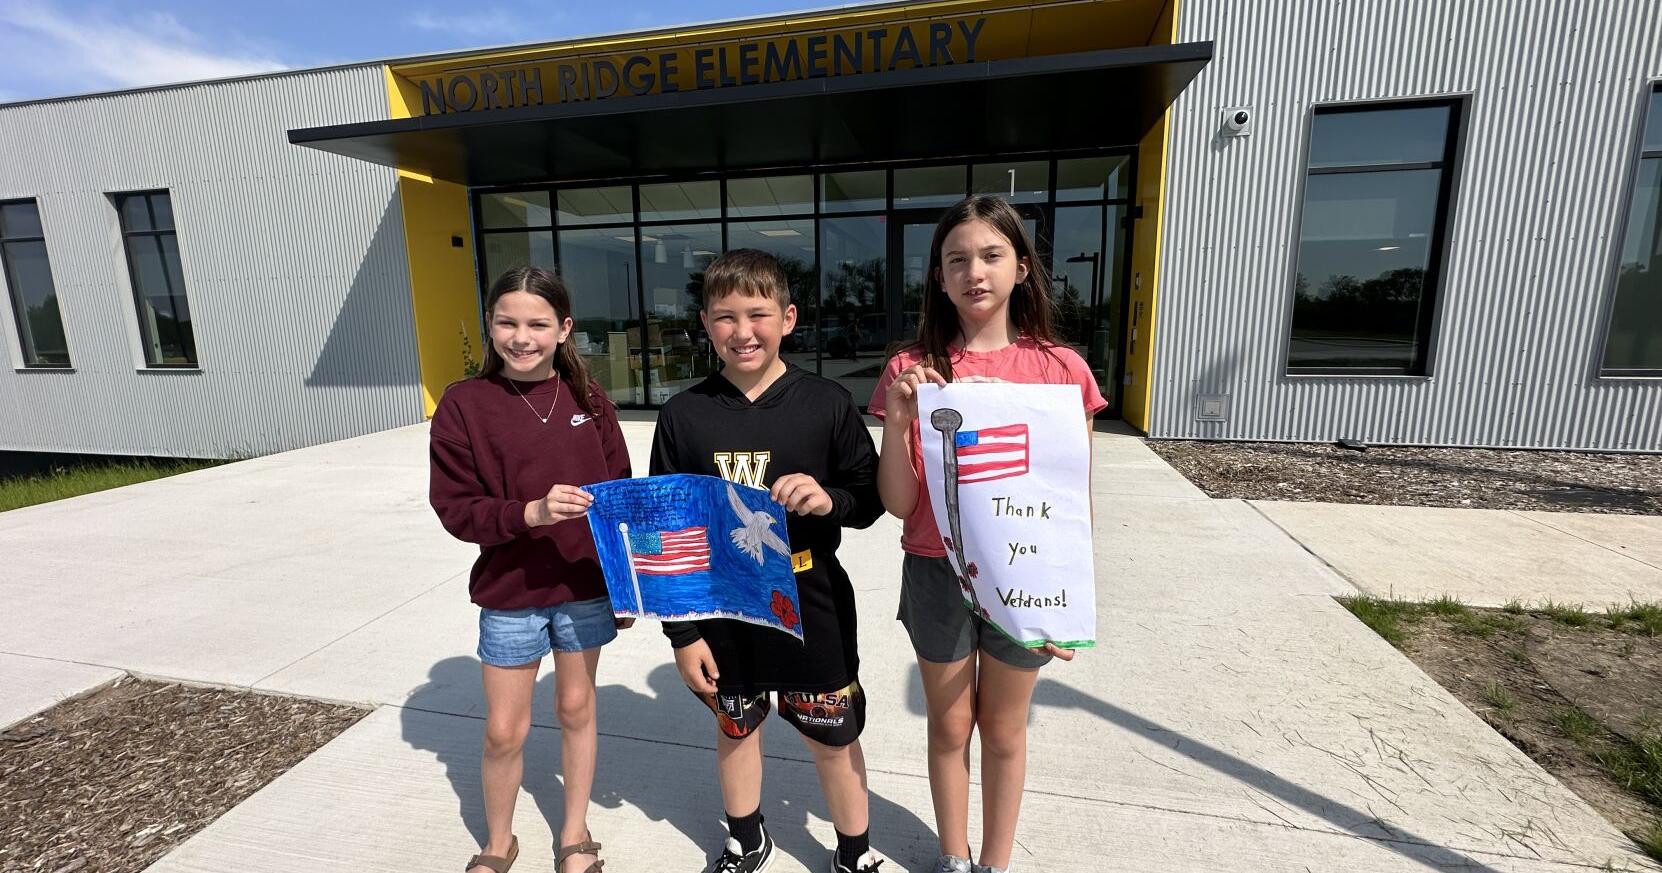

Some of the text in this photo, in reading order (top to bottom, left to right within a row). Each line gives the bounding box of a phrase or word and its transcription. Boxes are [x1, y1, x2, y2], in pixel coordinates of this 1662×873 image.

[419, 18, 987, 116] NORTH RIDGE ELEMENTARY
[1007, 168, 1016, 197] 1
[713, 451, 771, 491] W
[991, 496, 1052, 520] Thank
[1008, 542, 1038, 566] you
[995, 586, 1068, 608] Veterans!
[797, 714, 844, 724] NATIONALS
